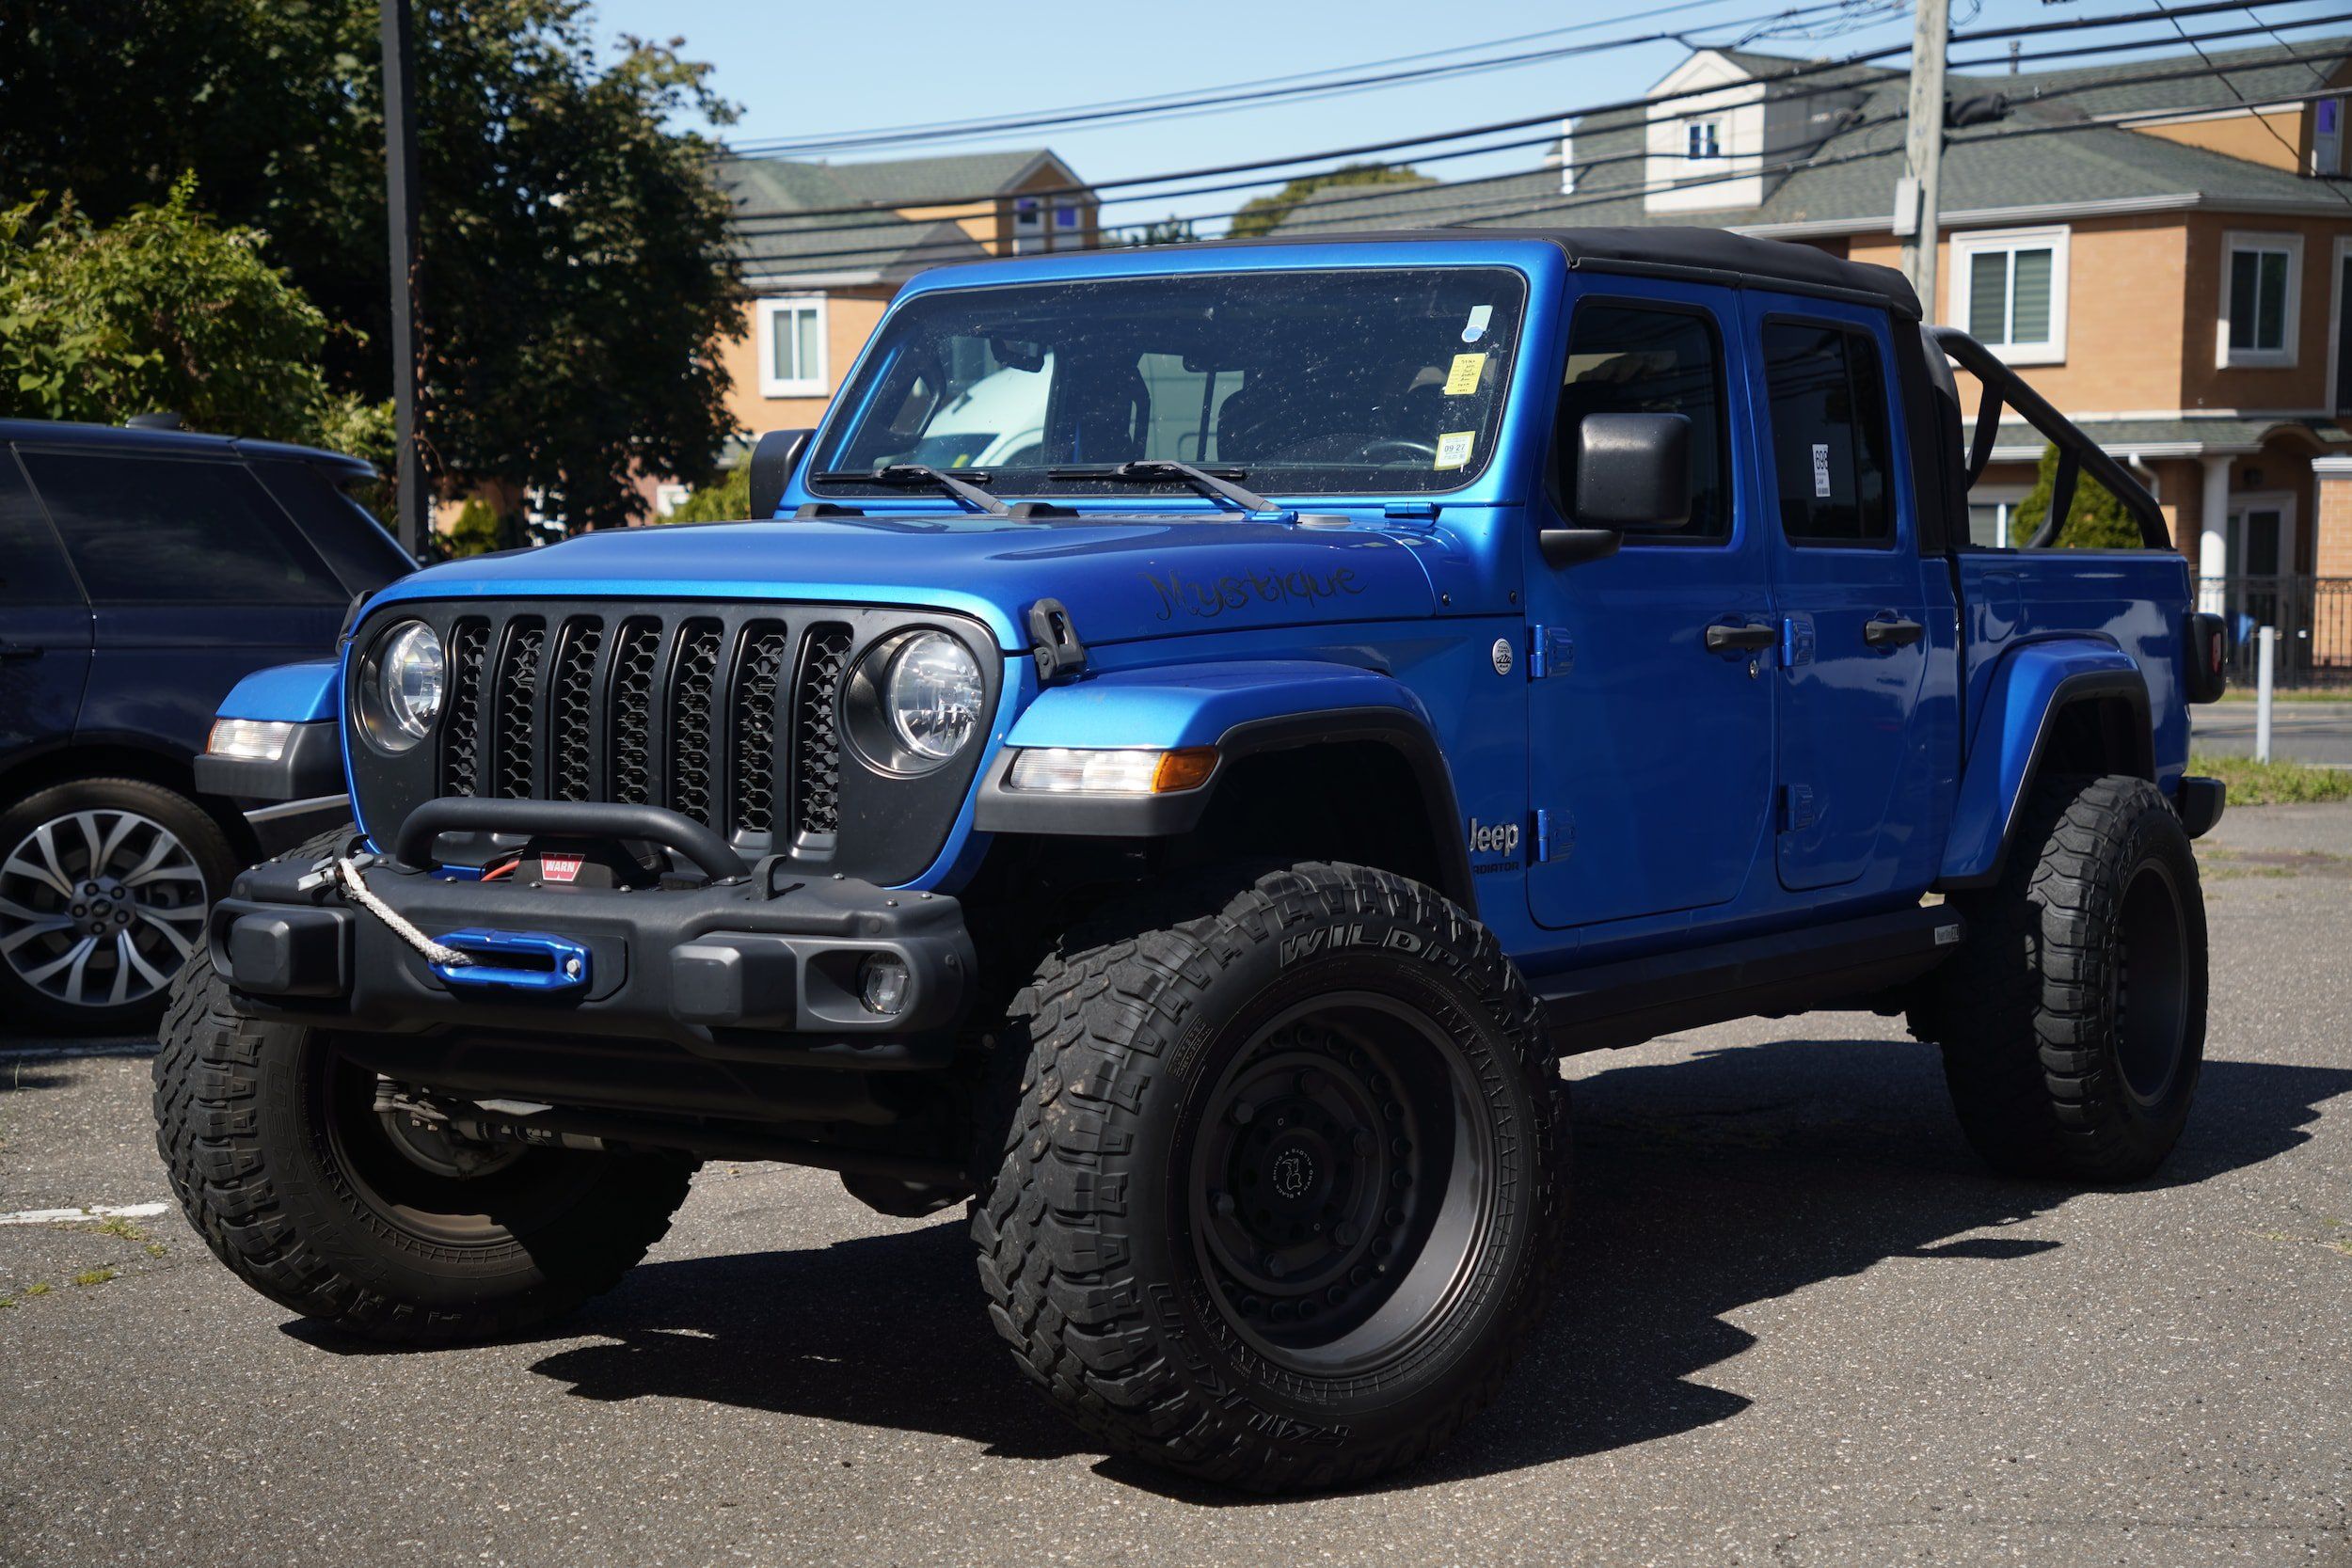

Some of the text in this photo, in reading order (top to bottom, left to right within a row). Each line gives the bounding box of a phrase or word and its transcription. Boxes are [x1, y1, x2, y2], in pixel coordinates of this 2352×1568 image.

[1136, 563, 1368, 621] Mystique
[1470, 817, 1519, 857] Jeep
[546, 860, 576, 873] WARN
